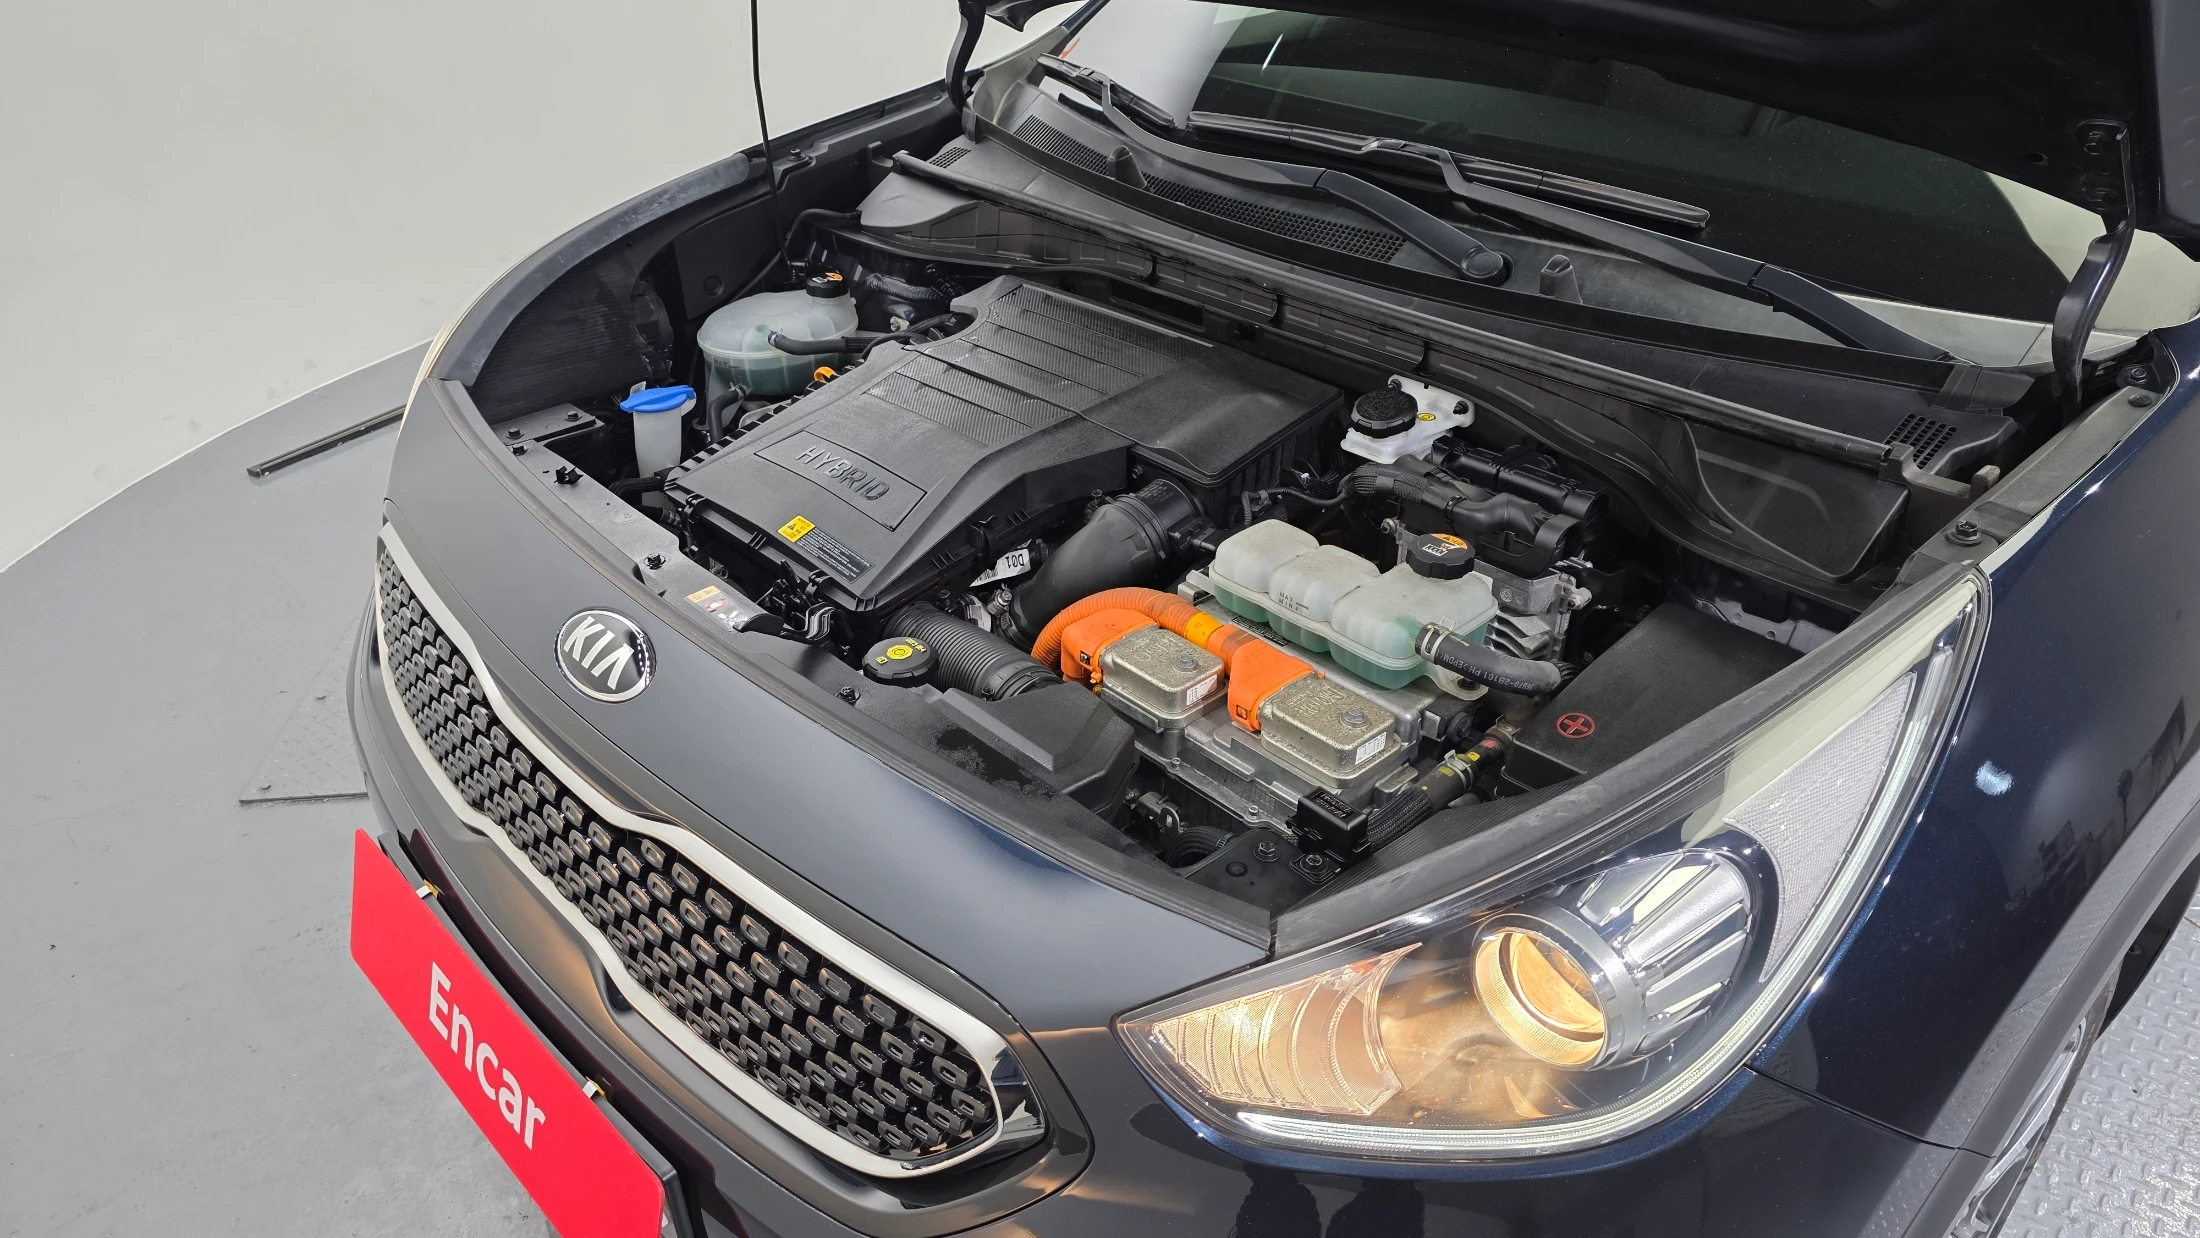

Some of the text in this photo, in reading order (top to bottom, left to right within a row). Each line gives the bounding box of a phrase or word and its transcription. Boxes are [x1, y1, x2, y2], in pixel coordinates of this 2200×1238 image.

[794, 445, 890, 501] HYBRID
[1278, 597, 1294, 609] MIN
[1280, 591, 1294, 602] MAX
[563, 615, 635, 690] KIA
[428, 960, 546, 1151] Encar
